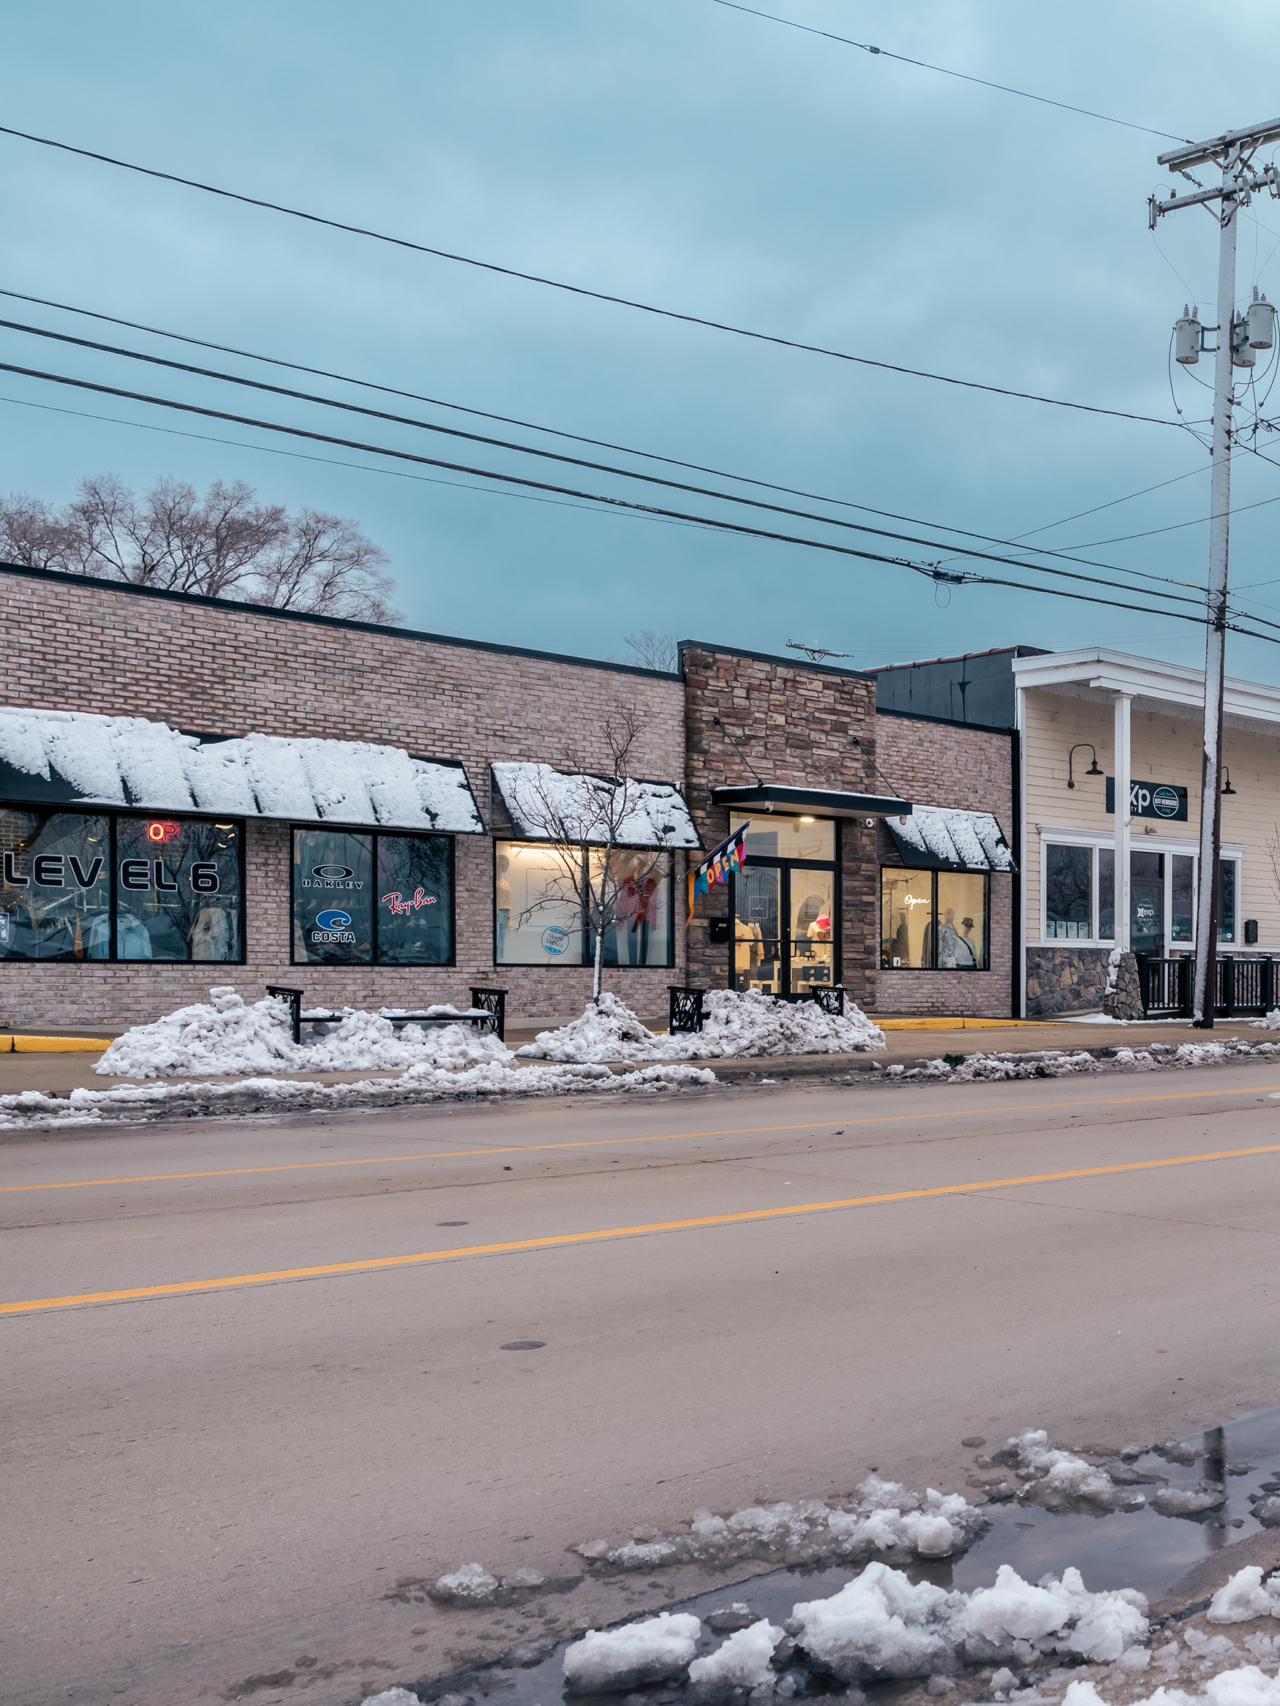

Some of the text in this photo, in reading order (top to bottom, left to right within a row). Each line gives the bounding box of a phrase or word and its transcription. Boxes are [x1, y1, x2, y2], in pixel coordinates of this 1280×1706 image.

[1130, 784, 1150, 813] xp
[706, 848, 739, 884] OPEN
[190, 861, 220, 893] 6
[302, 879, 364, 889] OAKLEY
[904, 894, 931, 910] Open
[311, 930, 356, 943] COSTA
[545, 938, 564, 949] SMALL
